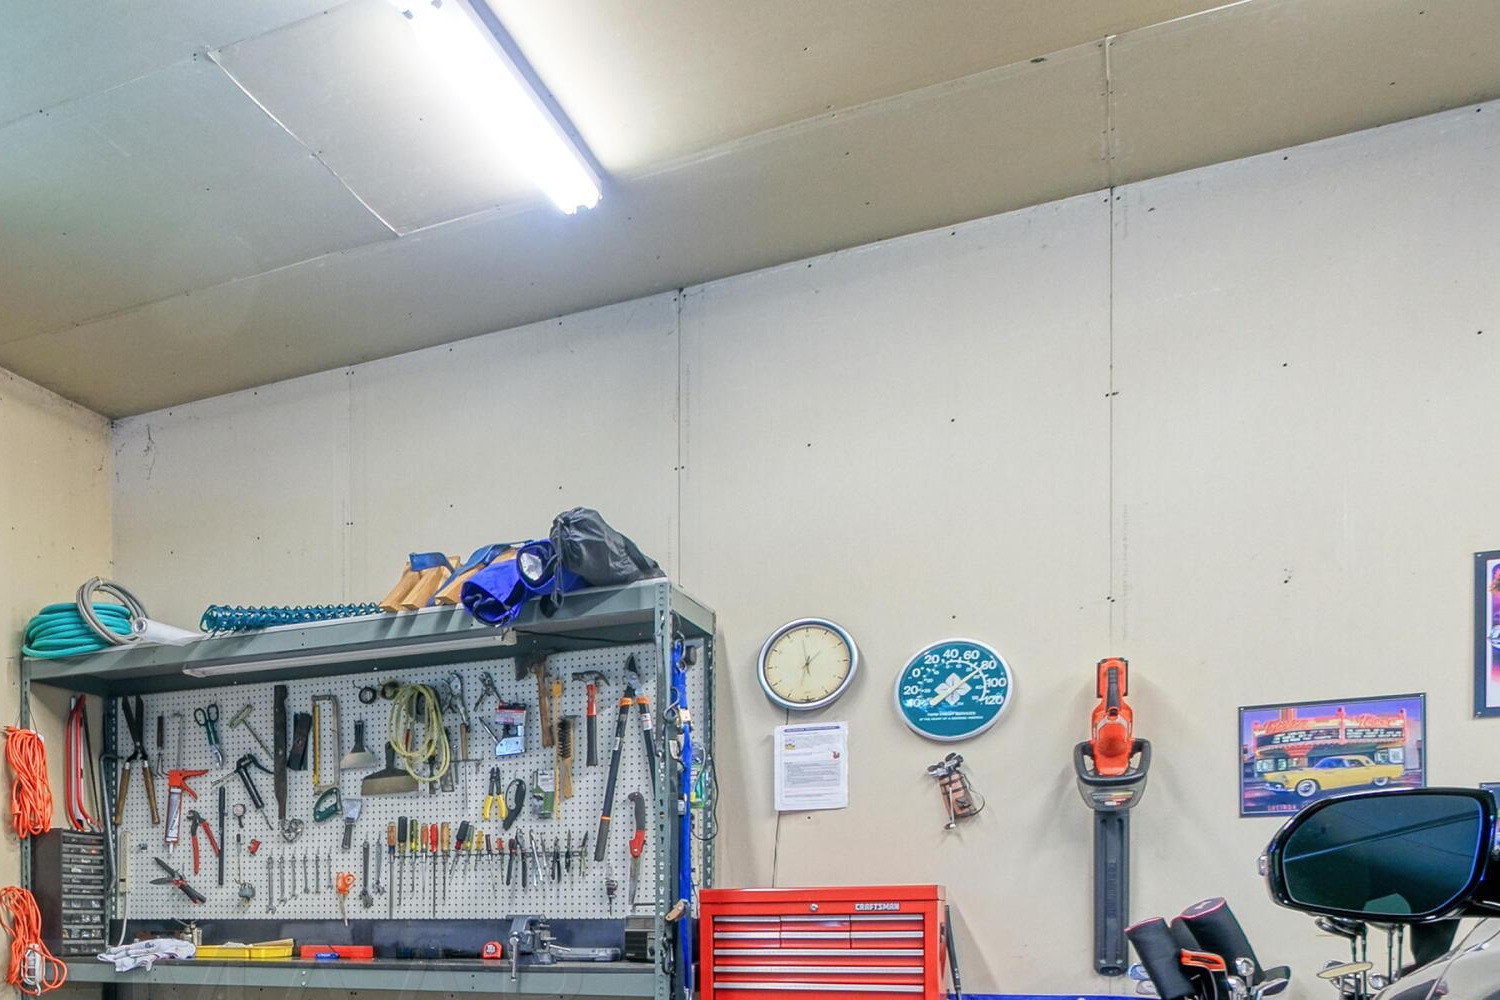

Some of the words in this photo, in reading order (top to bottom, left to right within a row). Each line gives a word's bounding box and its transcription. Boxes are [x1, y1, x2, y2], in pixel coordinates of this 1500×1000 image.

[943, 649, 959, 658] 40
[963, 650, 980, 660] 60
[924, 655, 940, 664] 20
[980, 660, 997, 670] 80
[912, 668, 921, 678] 0
[986, 678, 1007, 688] 100
[903, 686, 918, 695] 20
[984, 695, 1004, 705] 120
[855, 902, 900, 911] CRAFTSMAN
